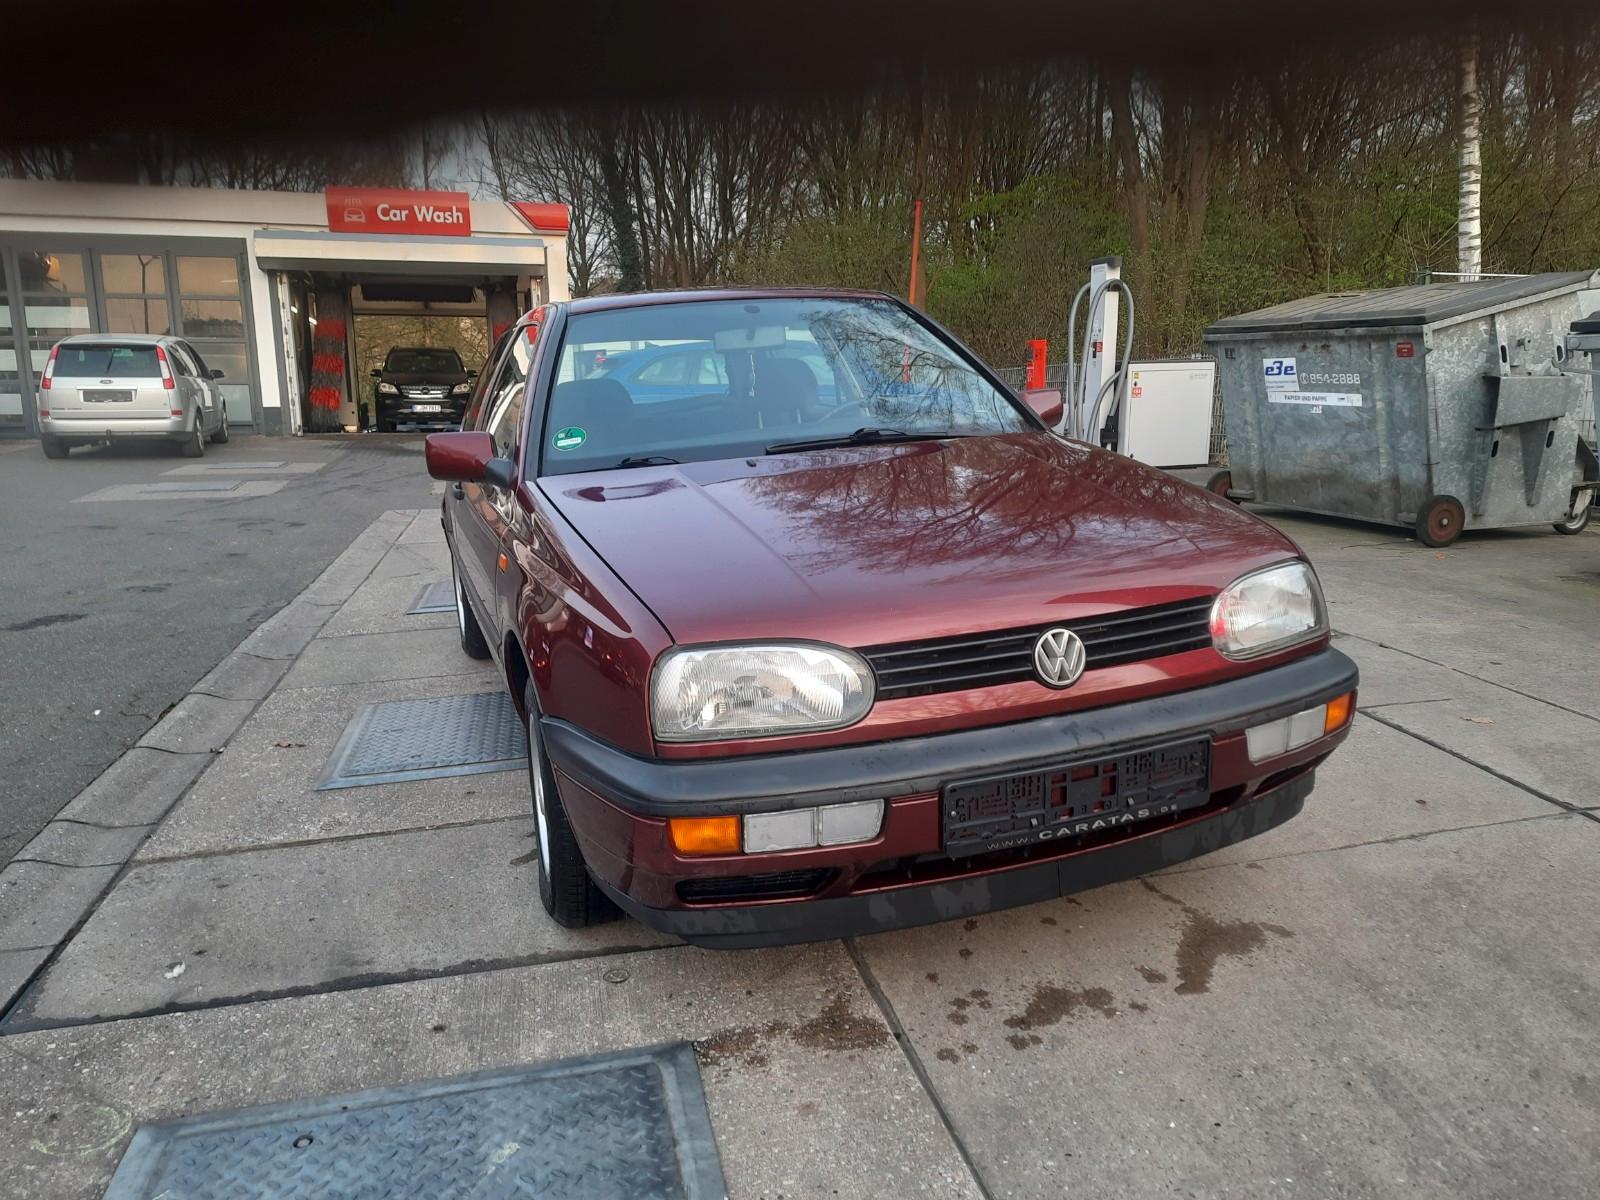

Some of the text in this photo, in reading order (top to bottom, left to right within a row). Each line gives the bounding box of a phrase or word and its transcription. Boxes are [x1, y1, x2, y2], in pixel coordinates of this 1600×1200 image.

[377, 204, 463, 224] Car Wash
[1265, 361, 1296, 376] e3e
